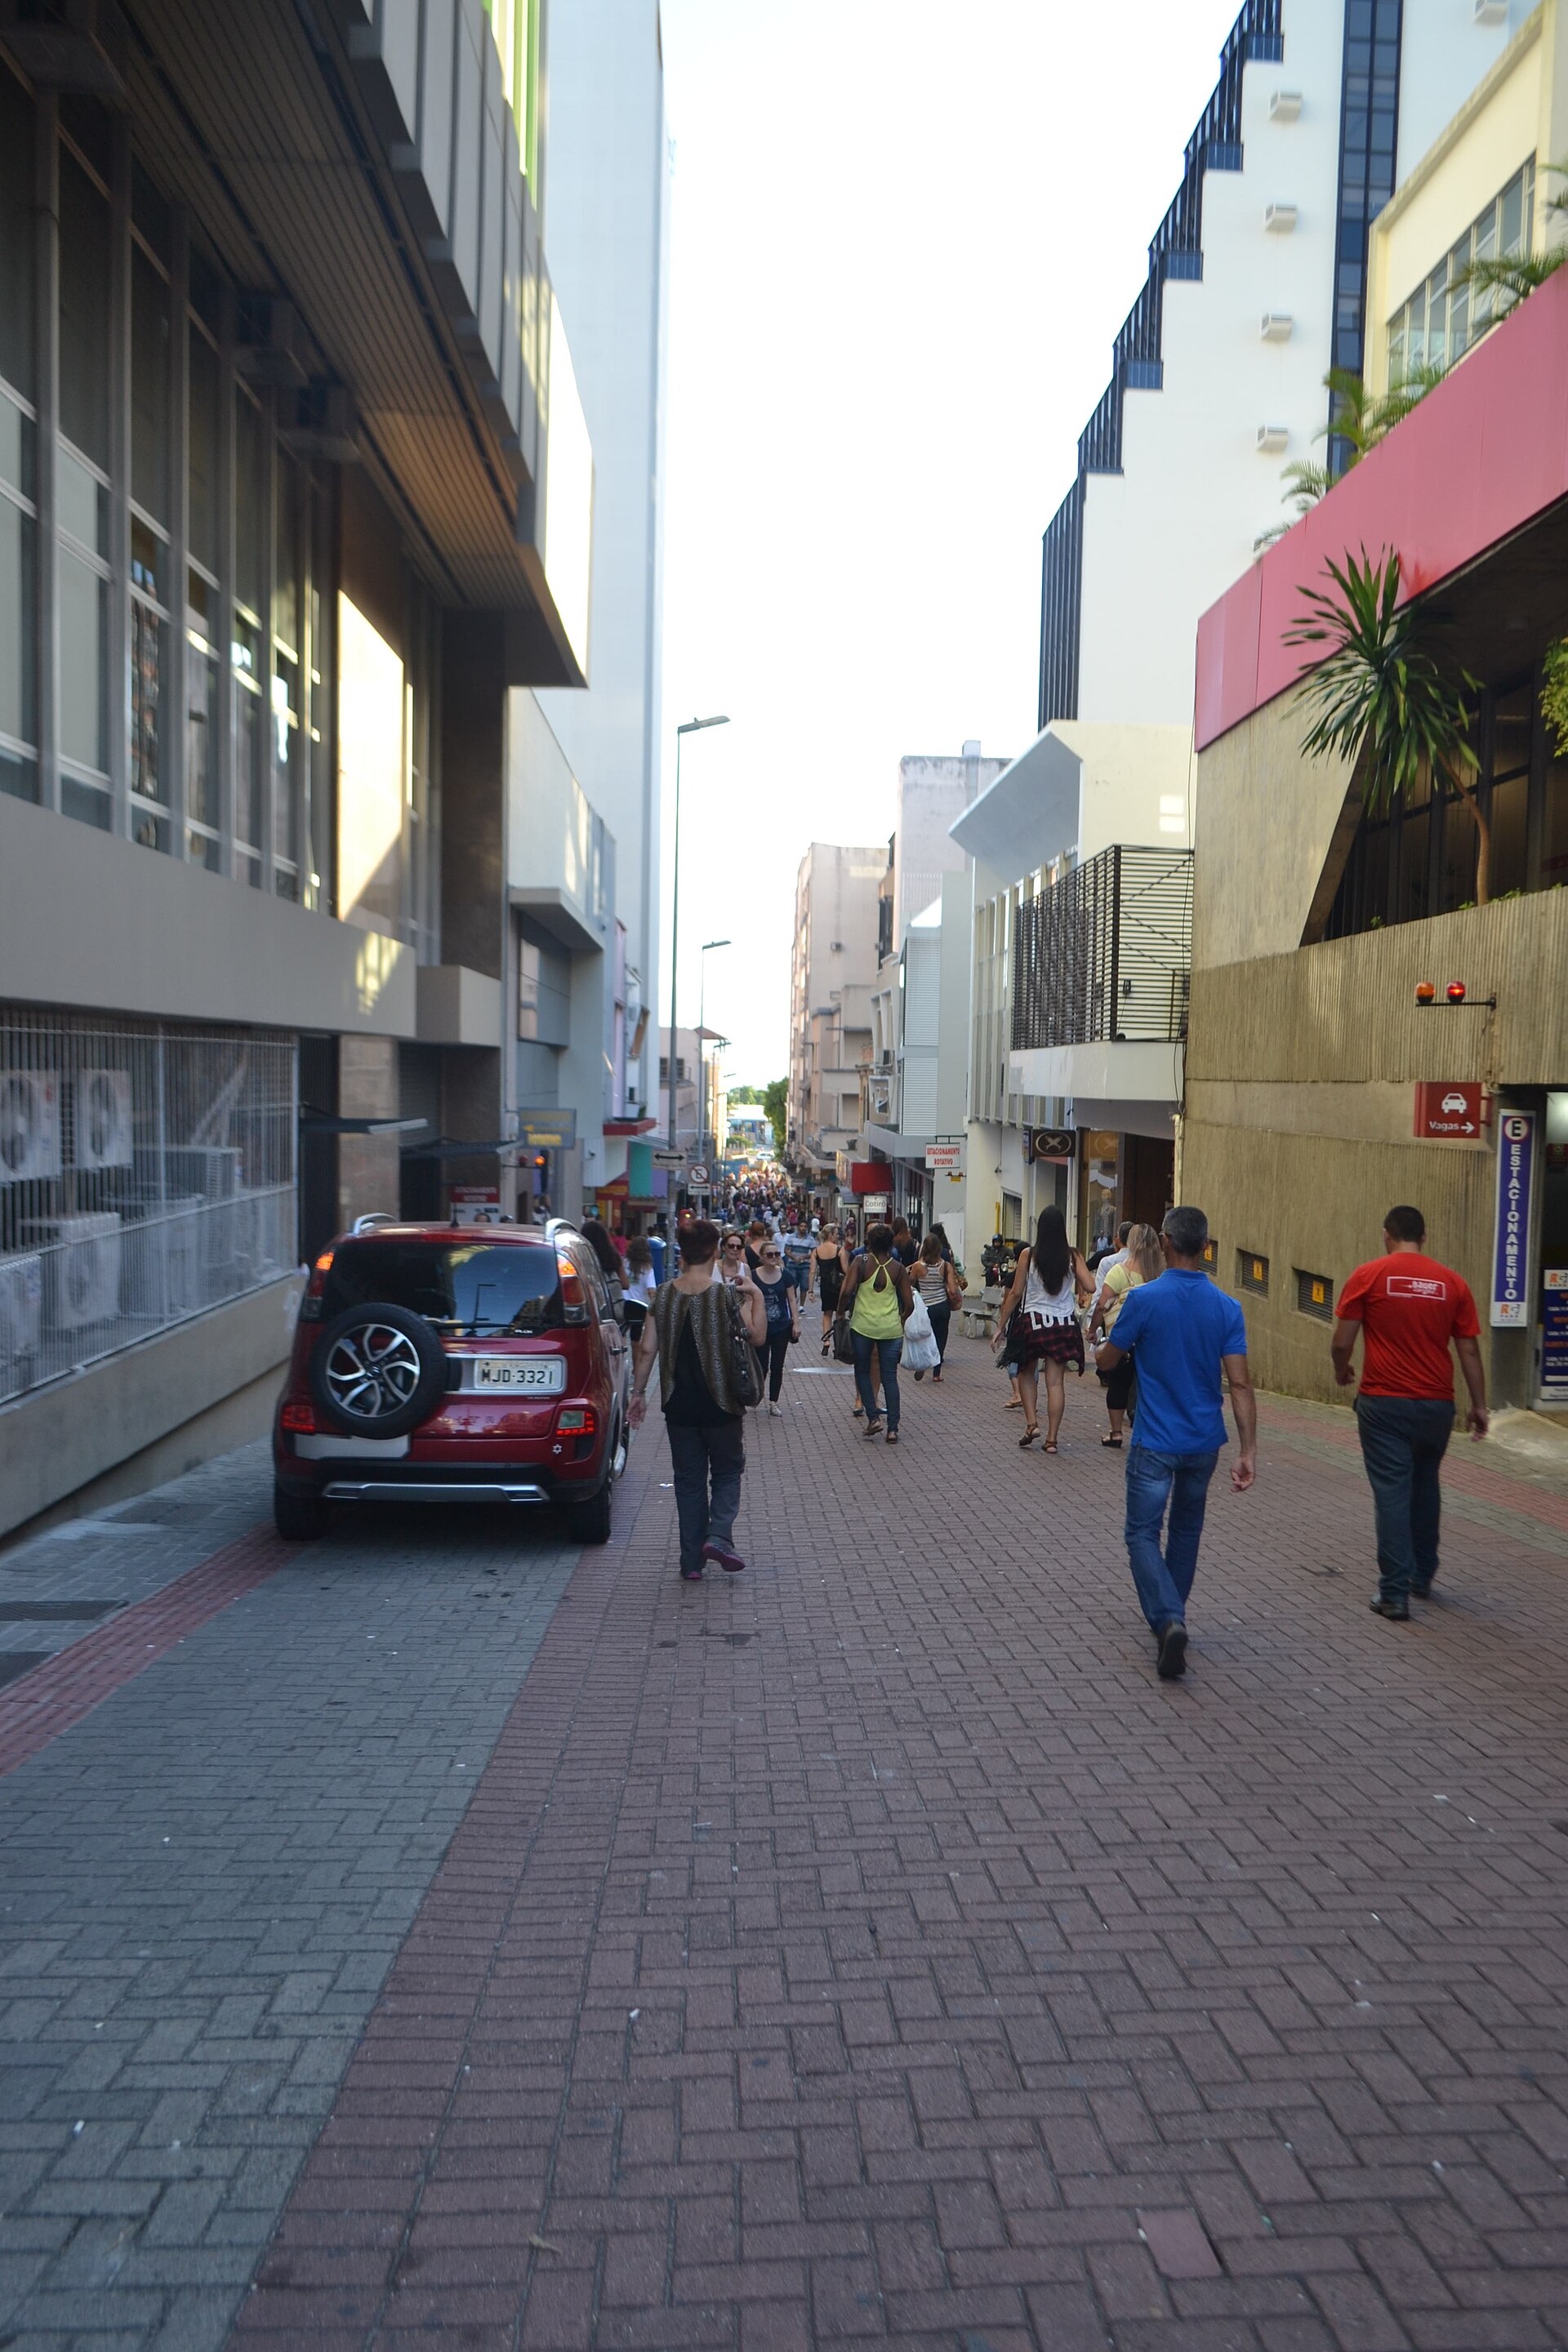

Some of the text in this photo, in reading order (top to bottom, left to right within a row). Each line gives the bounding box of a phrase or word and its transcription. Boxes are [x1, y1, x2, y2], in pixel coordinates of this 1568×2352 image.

[1429, 1121, 1459, 1132] Vagas
[1511, 1120, 1521, 1137] E
[1504, 1144, 1521, 1300] ESTACIONAMENTO
